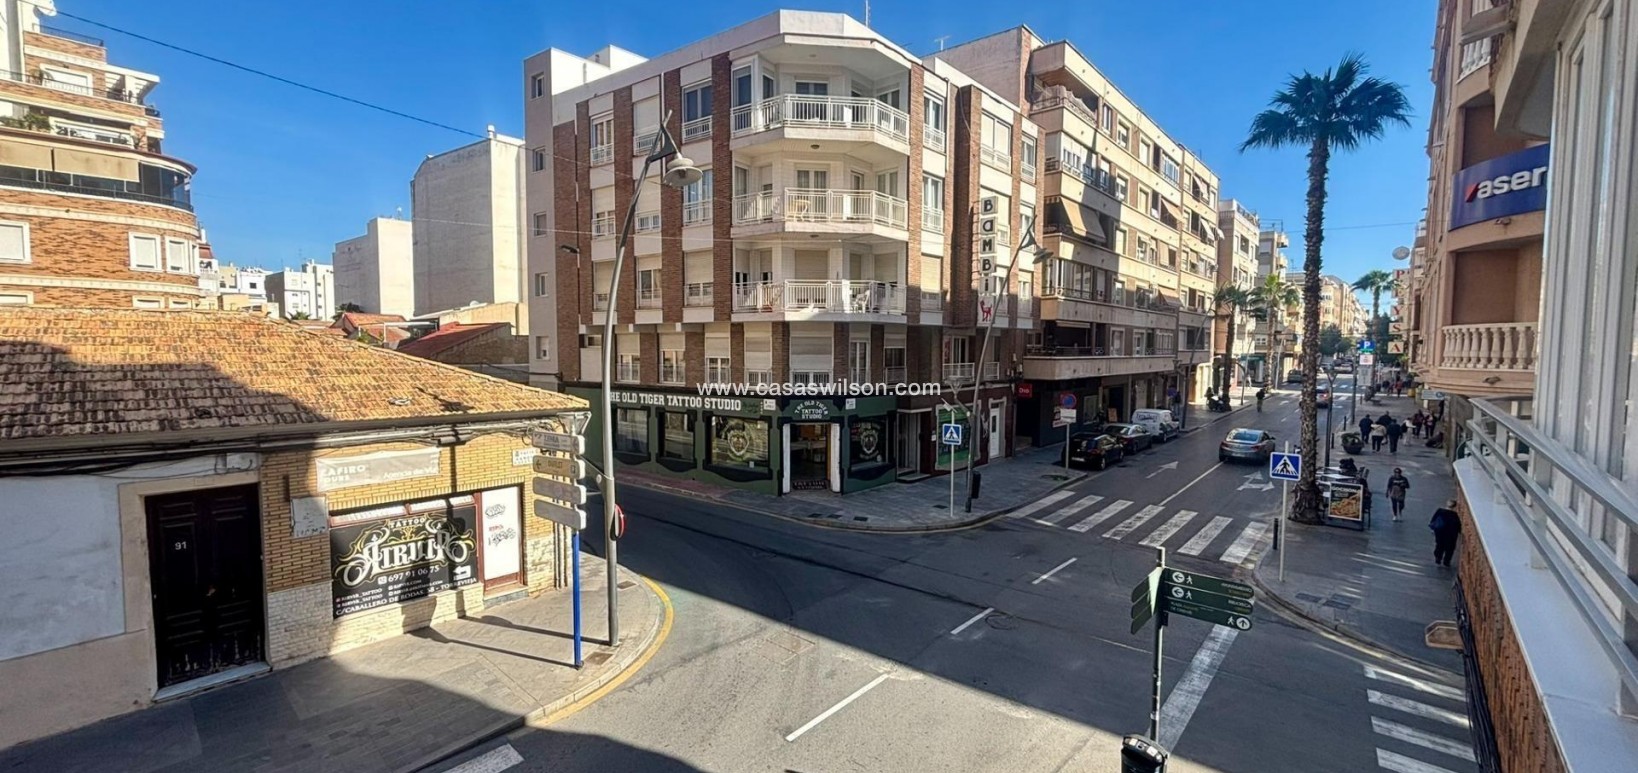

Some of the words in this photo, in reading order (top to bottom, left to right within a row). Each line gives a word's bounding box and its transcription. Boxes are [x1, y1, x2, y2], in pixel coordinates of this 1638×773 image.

[1363, 341, 1371, 349] P
[610, 391, 621, 402] HE
[622, 392, 638, 404] OLD
[638, 393, 665, 406] TIGER
[666, 395, 702, 408] TATTOO
[704, 398, 742, 411] STUDIO
[794, 403, 804, 414] THE
[390, 517, 426, 528] TATTOO
[174, 541, 187, 550] 91
[388, 572, 404, 582] 697
[429, 565, 440, 573] 75
[388, 595, 400, 604] DE
